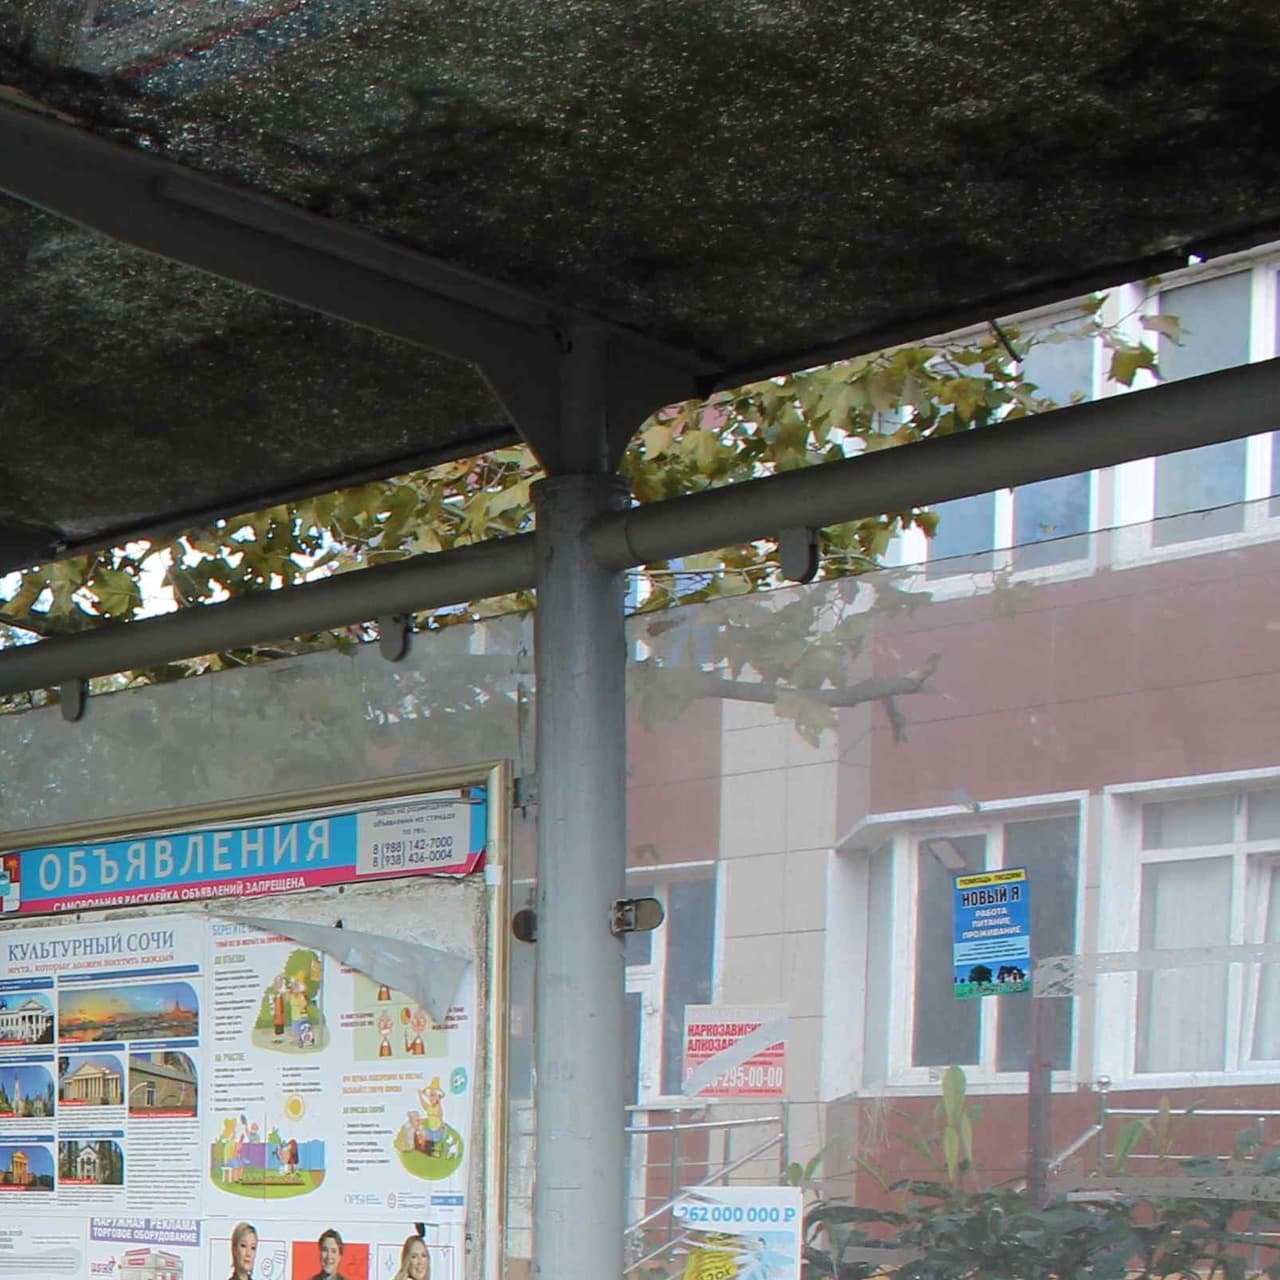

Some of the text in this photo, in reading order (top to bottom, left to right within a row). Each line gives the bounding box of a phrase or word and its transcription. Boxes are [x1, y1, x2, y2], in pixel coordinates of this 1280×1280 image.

[408, 836, 453, 851] 142-7000
[39, 819, 331, 891] ОБЪЯВЛЕНИЯ
[408, 849, 453, 864] 436-0004
[181, 880, 244, 900] ОБЪЯВЛЕНИЙ
[245, 876, 306, 895] ЗАПРЕЩЕНА
[962, 885, 1020, 907] НОВЫЙ Я
[7, 930, 174, 962] КУЛЬТУРНЫЙ СОЧИ
[711, 1206, 744, 1222] 000
[747, 1207, 780, 1223] 000
[93, 1227, 198, 1243] ТОРГОВОЕ ОБОРУДОВАНИЕ
